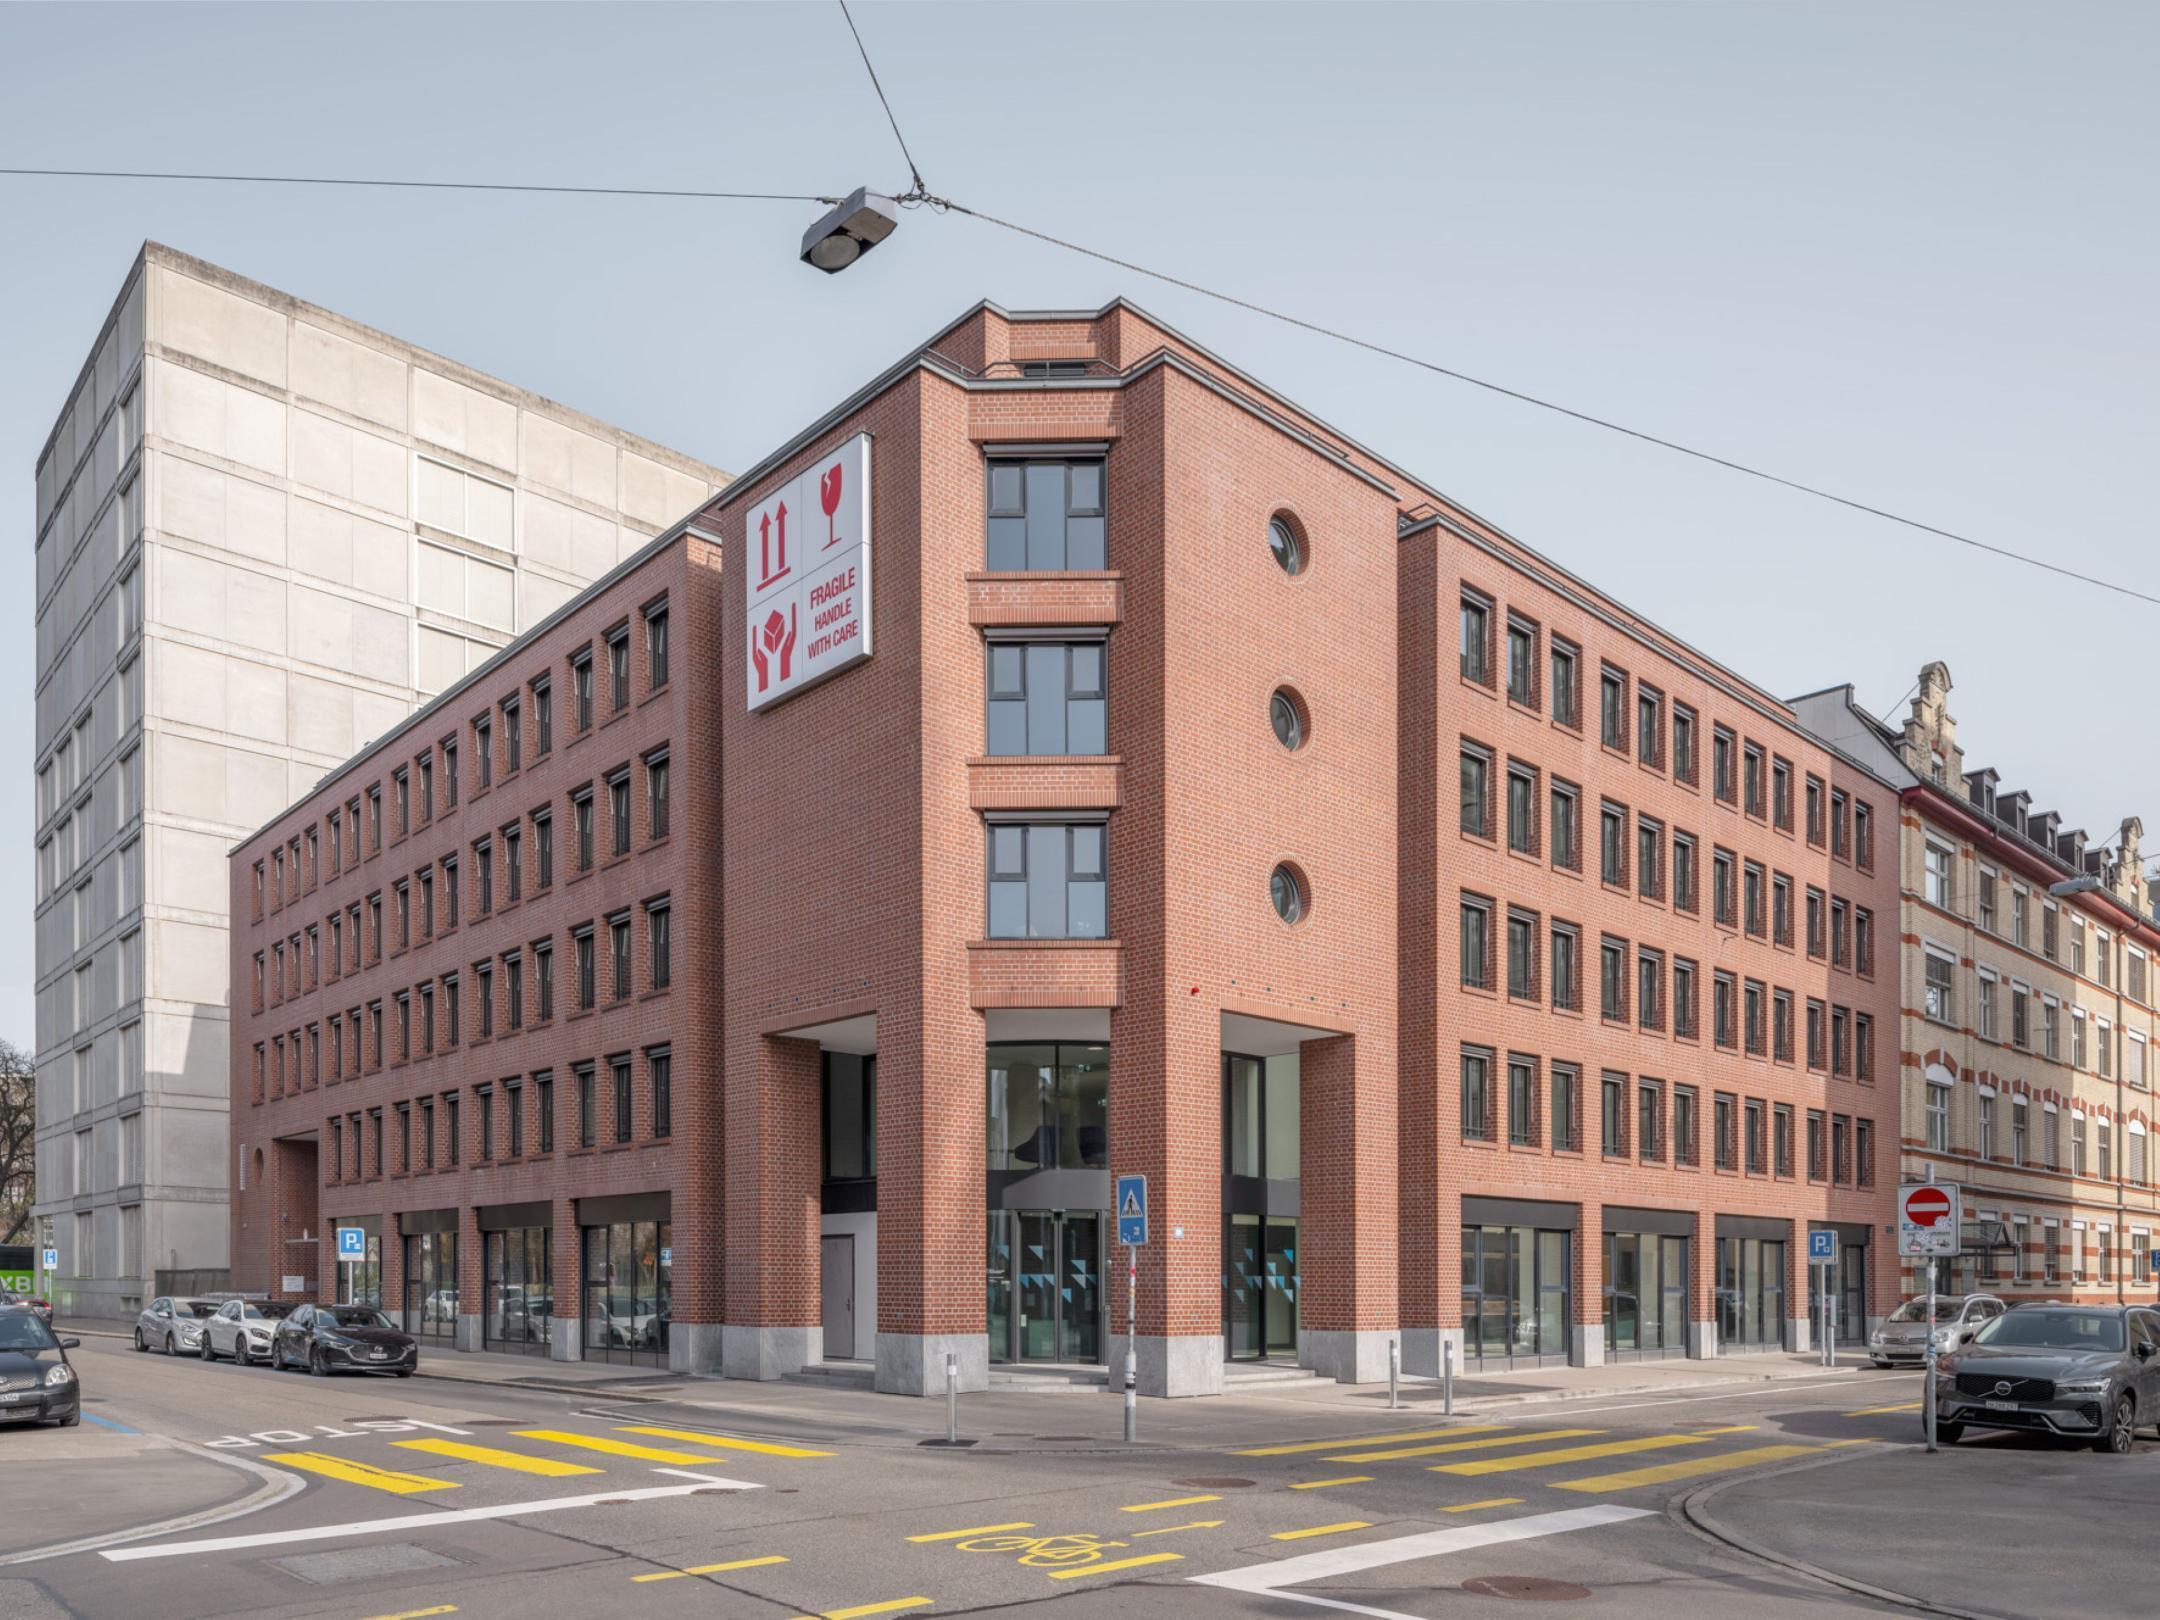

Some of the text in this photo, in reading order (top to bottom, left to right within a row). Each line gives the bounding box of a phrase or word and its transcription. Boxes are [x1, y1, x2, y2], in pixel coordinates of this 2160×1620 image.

[810, 567, 855, 610] FRAGILE
[815, 597, 852, 632] HANDLE
[808, 619, 858, 660] WITH CARE
[345, 1233, 357, 1249] P
[1815, 1236, 1827, 1253] P
[203, 1420, 419, 1448] STOP
